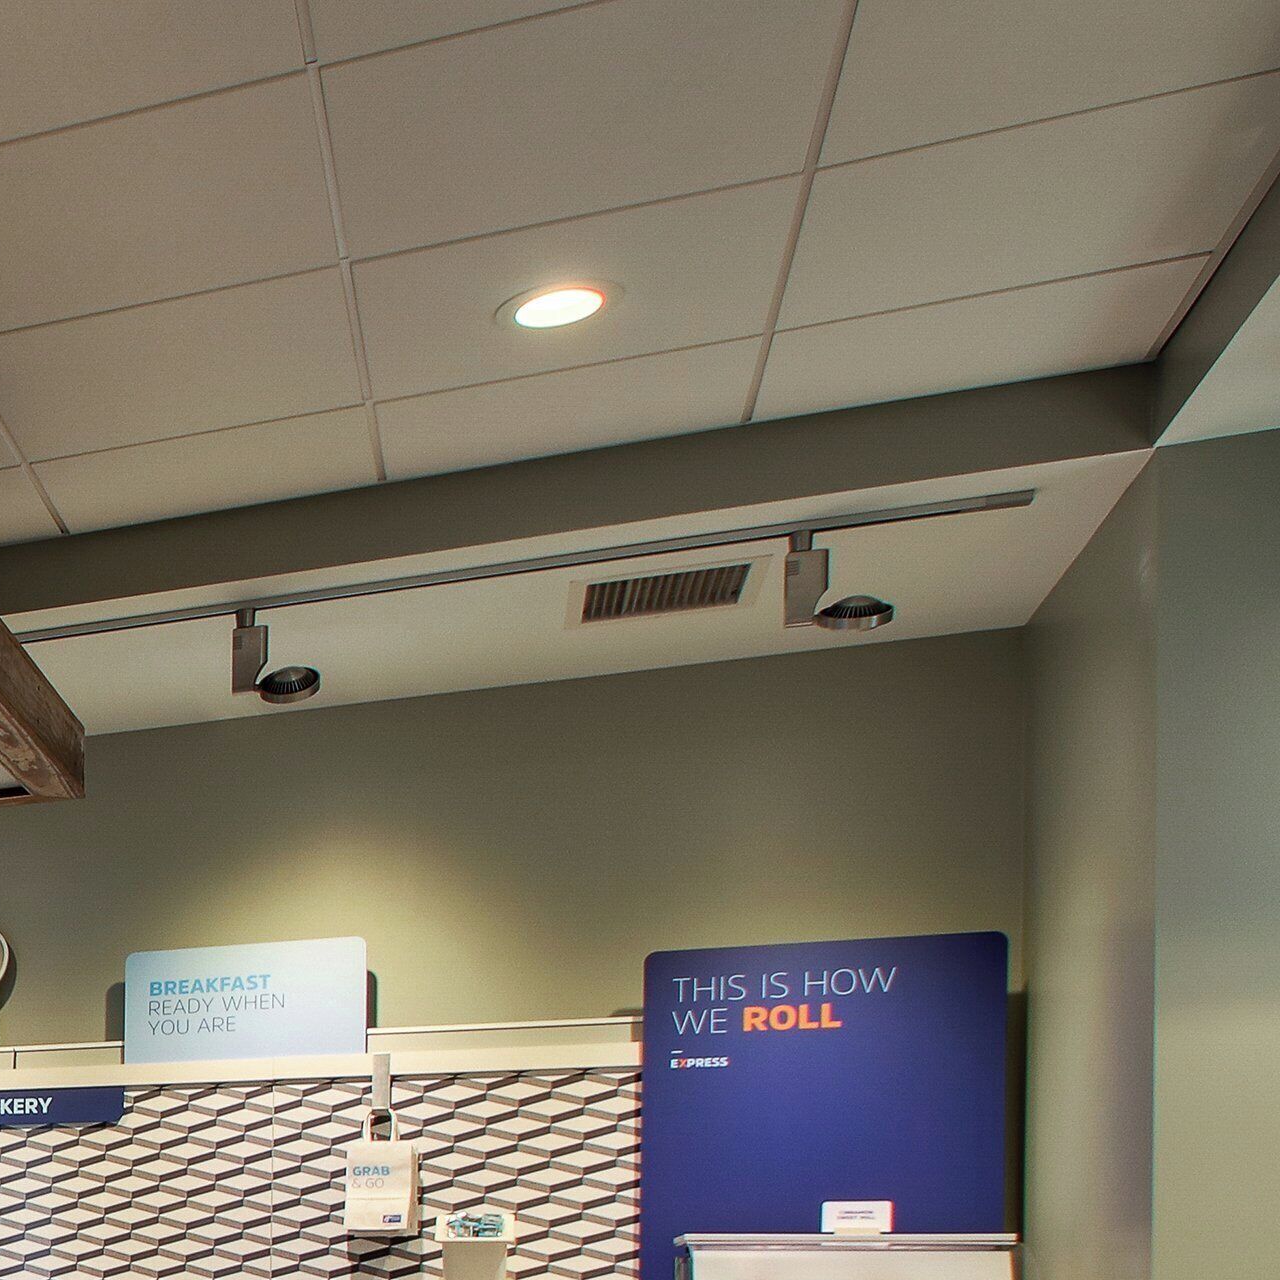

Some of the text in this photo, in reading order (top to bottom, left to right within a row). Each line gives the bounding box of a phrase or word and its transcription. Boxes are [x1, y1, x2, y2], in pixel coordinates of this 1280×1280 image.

[149, 974, 271, 997] BREAKFAST
[672, 966, 897, 1003] THIS IS HOW
[148, 993, 285, 1016] READY WHEN
[147, 1016, 236, 1036] YOU ARE
[671, 1002, 843, 1036] WE ROLL
[670, 1056, 730, 1069] EXPRESS
[353, 1166, 390, 1176] GRAB
[351, 1178, 385, 1188] & GO
